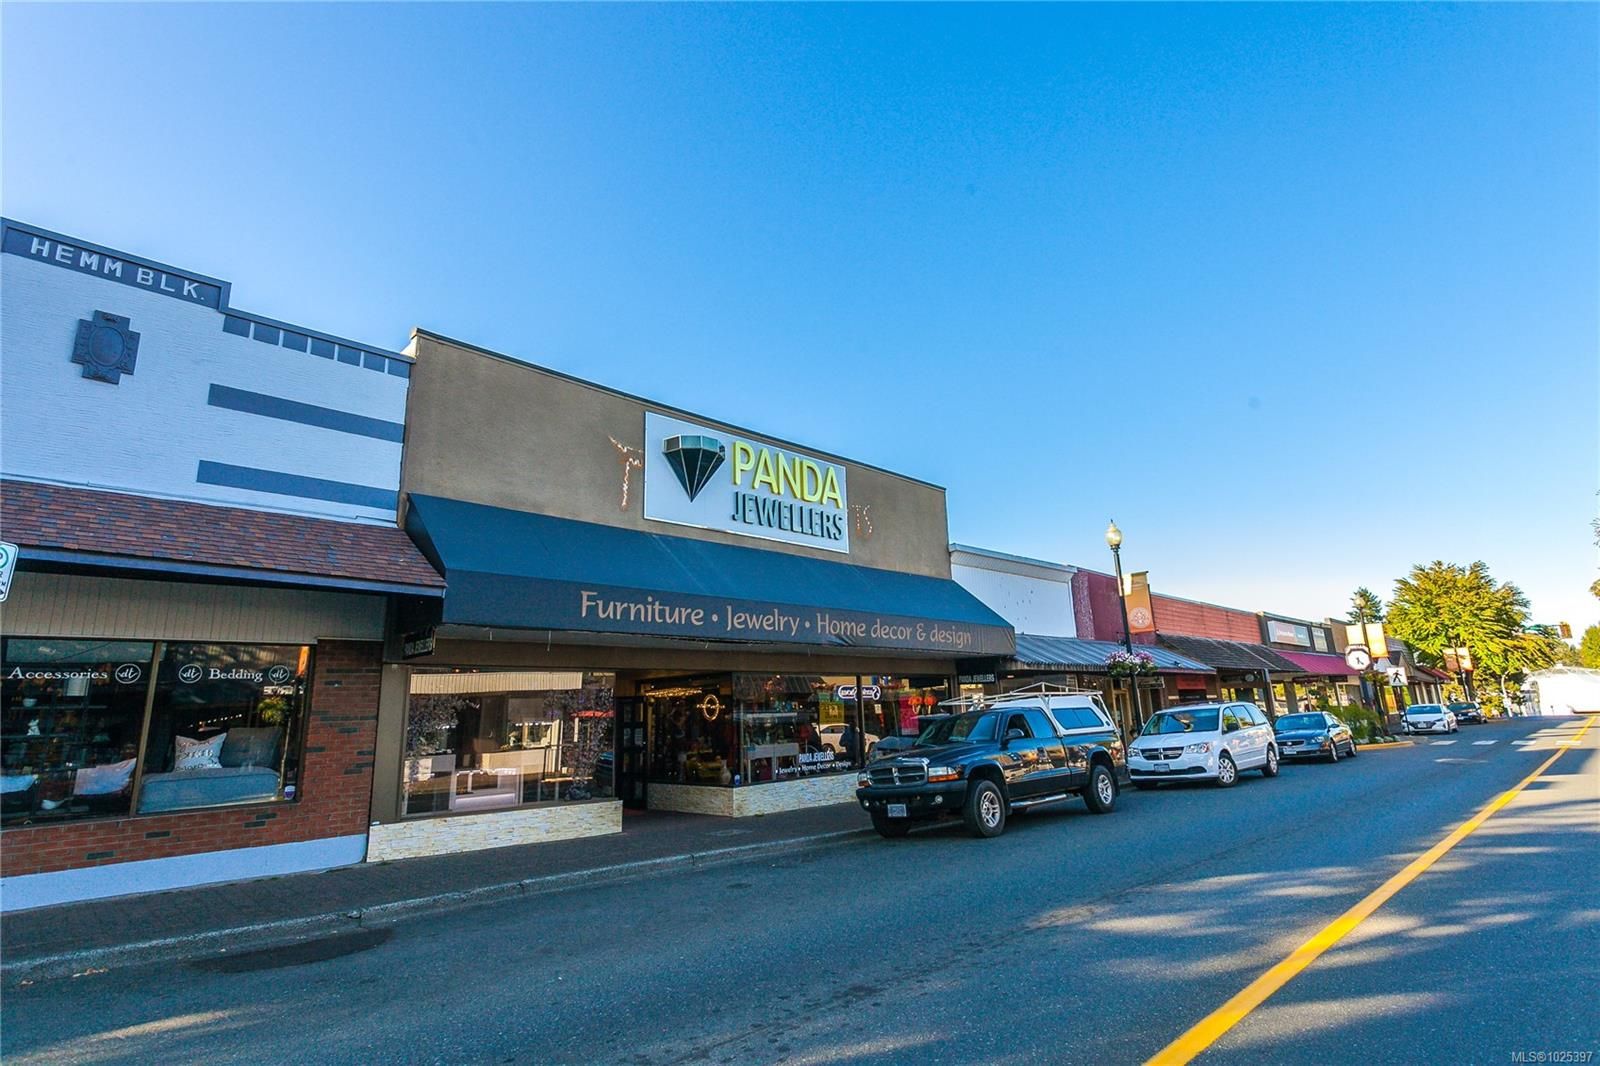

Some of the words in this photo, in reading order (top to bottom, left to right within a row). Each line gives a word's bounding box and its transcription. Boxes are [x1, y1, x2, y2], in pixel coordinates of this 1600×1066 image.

[30, 236, 123, 278] HEMM
[136, 266, 206, 300] BLK.
[732, 440, 843, 509] PANDA
[731, 491, 843, 541] JEWELLERS
[580, 590, 704, 625] Furniture
[726, 605, 799, 636] Jewelry
[816, 612, 866, 637] Home
[871, 618, 912, 641] decor
[916, 623, 926, 641] &
[930, 626, 971, 648] design
[8, 665, 108, 680] Accessories
[209, 668, 263, 682] Bedding
